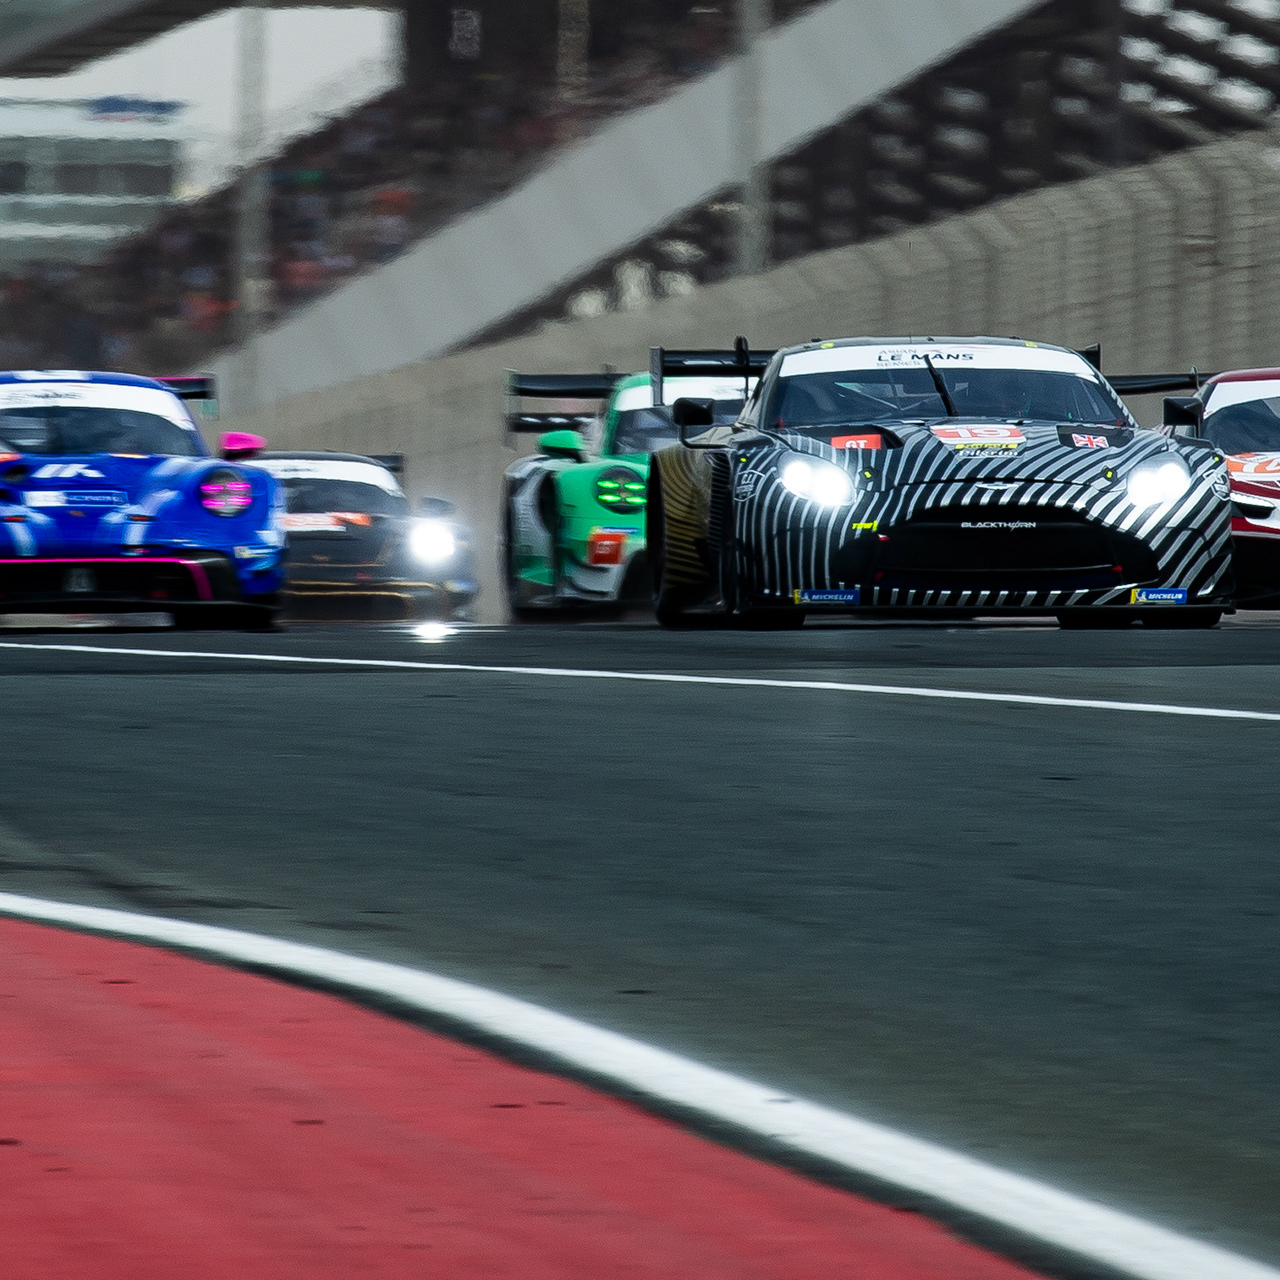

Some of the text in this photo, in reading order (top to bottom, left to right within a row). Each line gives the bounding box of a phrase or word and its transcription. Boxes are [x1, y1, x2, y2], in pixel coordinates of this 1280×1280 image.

[911, 353, 974, 361] MANS
[944, 428, 1012, 438] 19
[811, 593, 855, 601] MICHELIN
